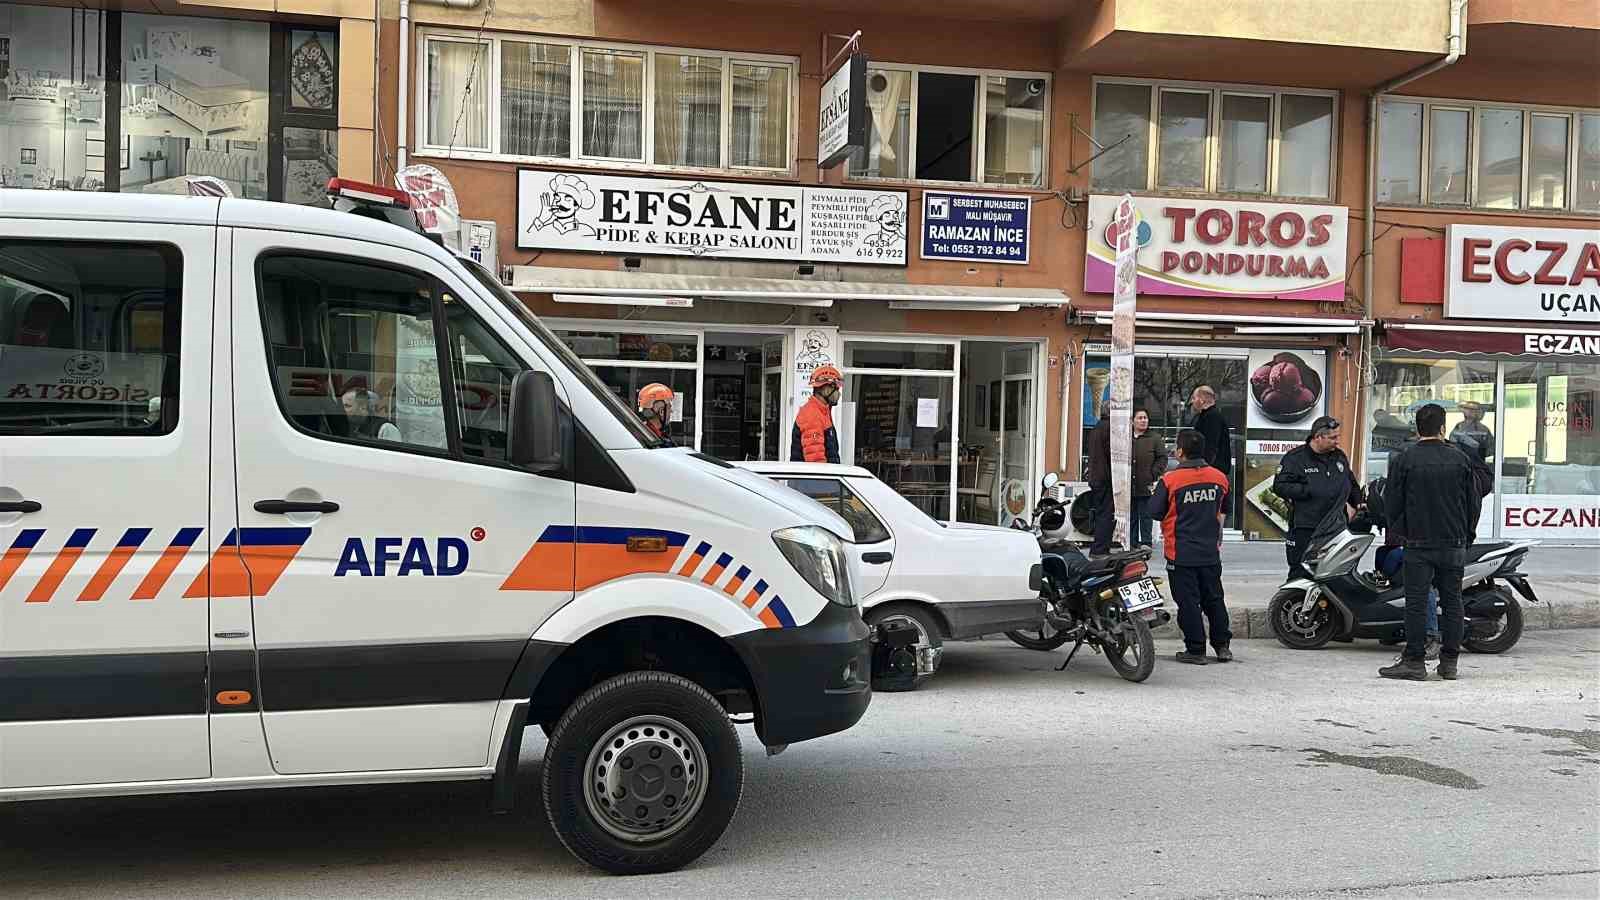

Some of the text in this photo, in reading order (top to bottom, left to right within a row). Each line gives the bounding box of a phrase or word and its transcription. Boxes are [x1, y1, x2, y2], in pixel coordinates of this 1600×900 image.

[820, 89, 849, 131] EFSANE
[811, 194, 847, 203] KIYMALI
[952, 198, 983, 208] SERBEST
[599, 188, 796, 232] EFSANE
[929, 224, 1024, 243] RAMAZAN İNCE
[1162, 206, 1333, 248] TOROS
[596, 225, 799, 250] PİDE & KEBAP SALONU
[810, 238, 839, 247] TAVUK
[810, 247, 841, 255] ADANA
[856, 247, 903, 258] 616 9 922
[933, 243, 1021, 256] Tel: 0552 792 84 94
[1162, 250, 1331, 279] DONDURMA
[1462, 237, 1600, 286] ECZA
[1541, 293, 1600, 317] UÇAN
[1183, 488, 1217, 504] AFAD
[1505, 507, 1600, 528] ECZAN
[334, 537, 469, 576] AFAD
[1120, 579, 1152, 597] 15 NF
[1138, 589, 1157, 602] 820
